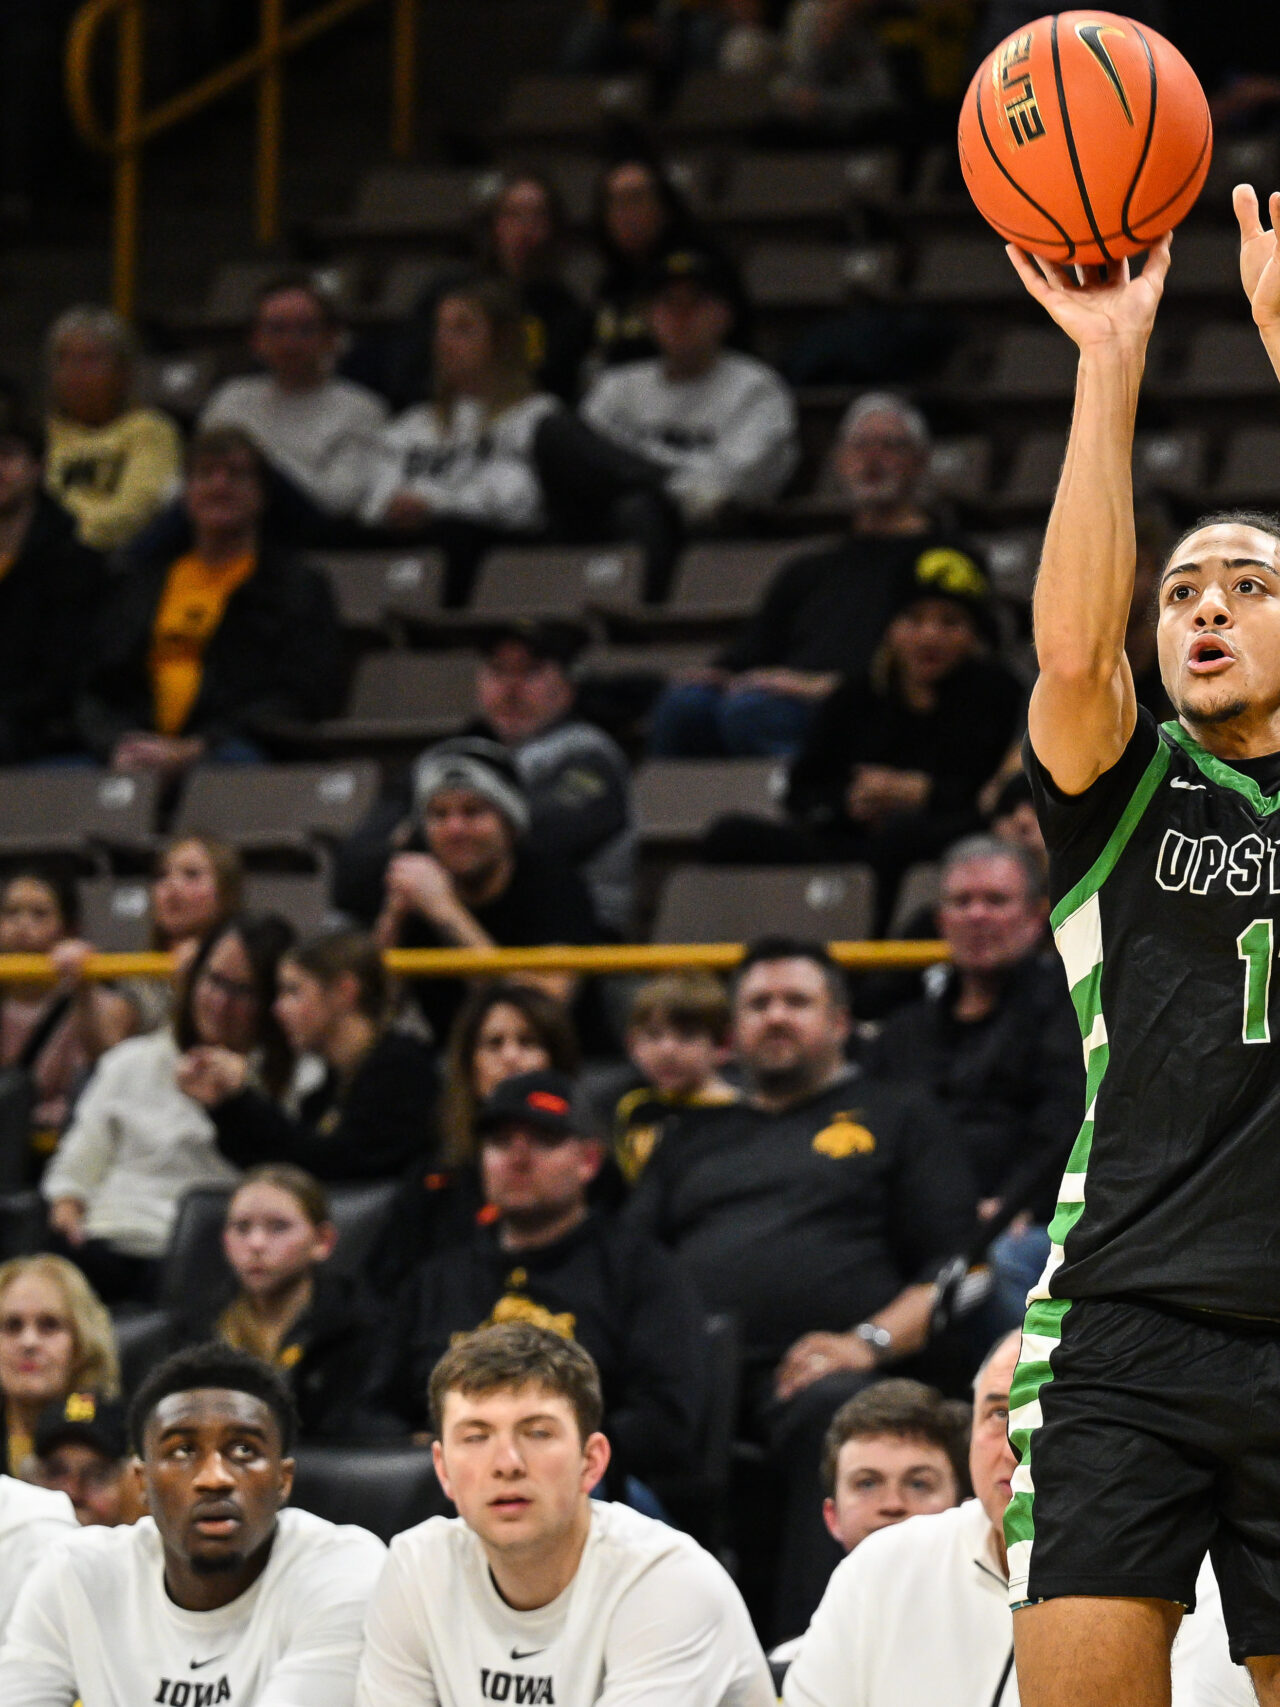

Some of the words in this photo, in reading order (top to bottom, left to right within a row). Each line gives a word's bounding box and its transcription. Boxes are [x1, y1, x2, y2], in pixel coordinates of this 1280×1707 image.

[1000, 31, 1047, 148] ELITE
[154, 1674, 231, 1707] IOWA
[480, 1667, 555, 1705] IOWA
